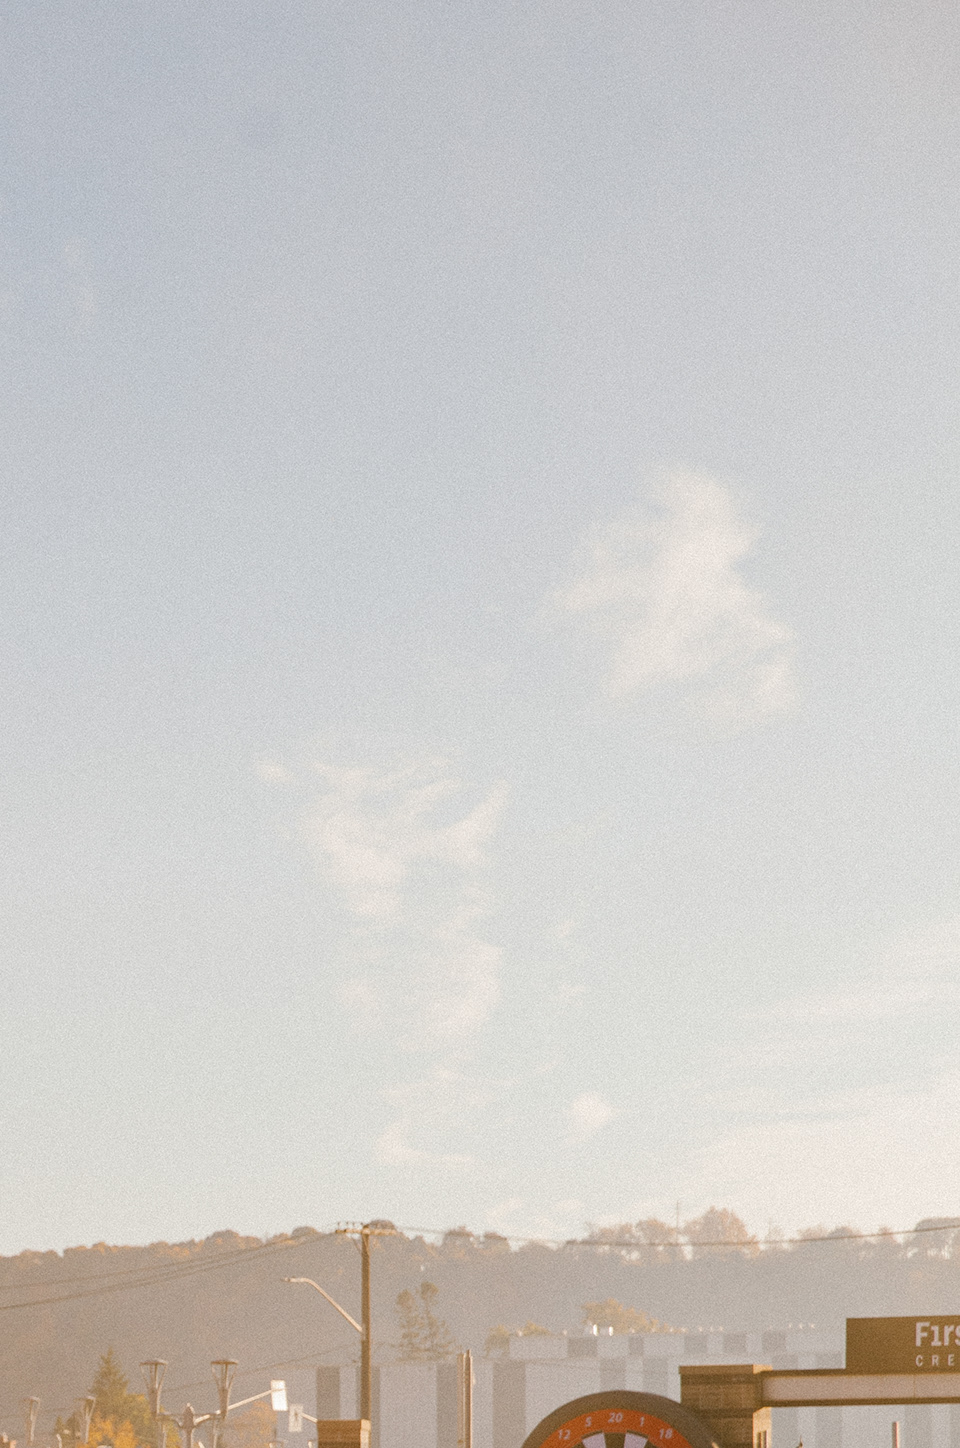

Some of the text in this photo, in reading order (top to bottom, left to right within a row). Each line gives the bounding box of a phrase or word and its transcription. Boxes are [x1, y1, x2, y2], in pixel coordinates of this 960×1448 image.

[607, 1412, 624, 1423] 20
[639, 1417, 645, 1427] 1
[558, 1429, 571, 1440] 12
[659, 1428, 673, 1439] 18
